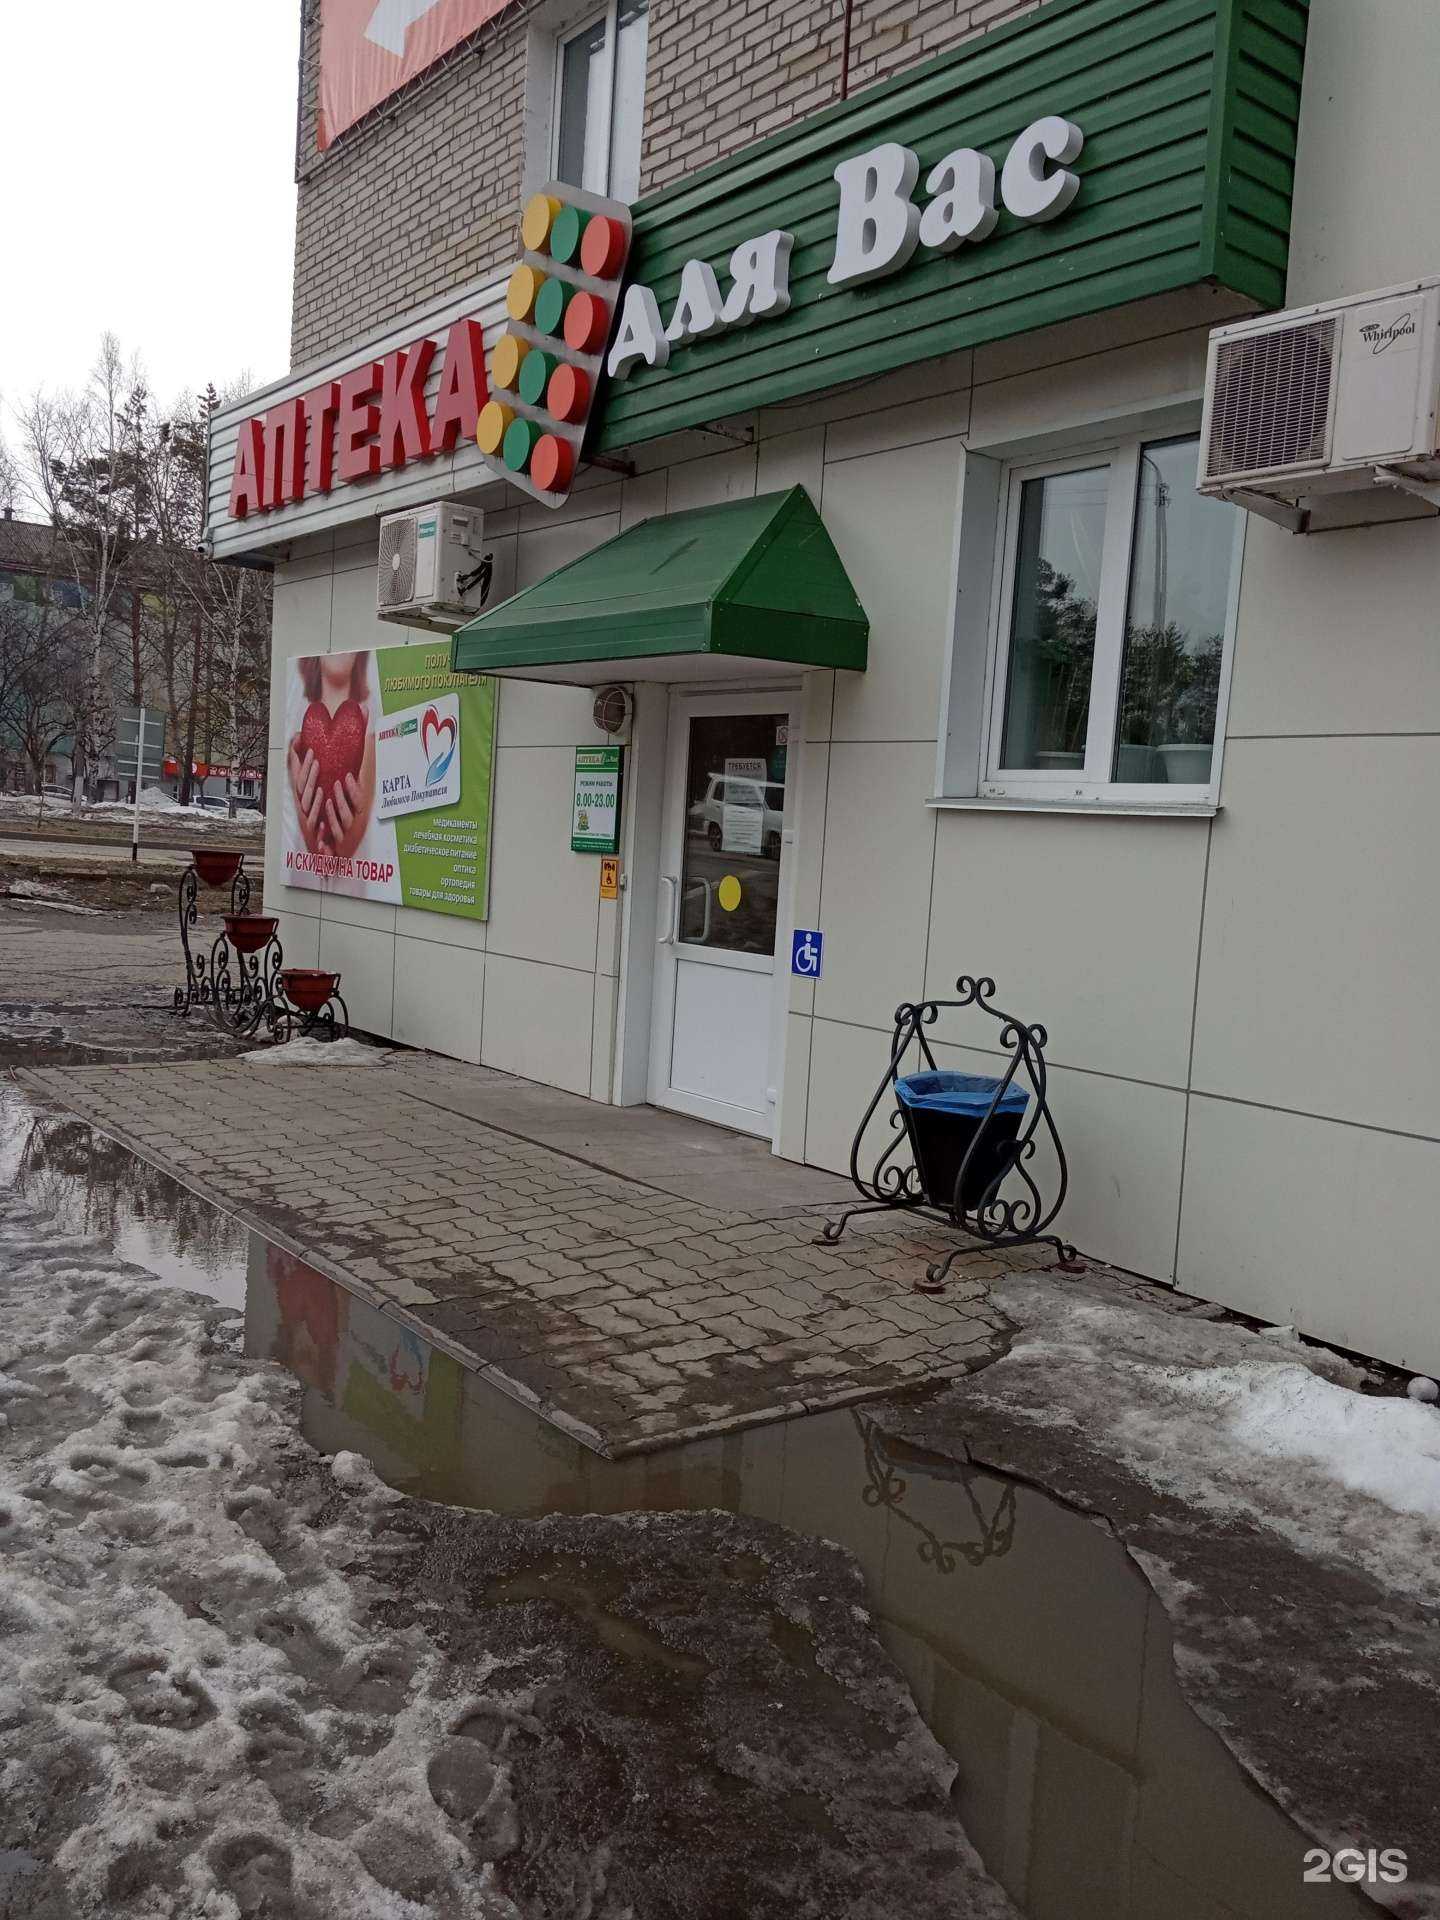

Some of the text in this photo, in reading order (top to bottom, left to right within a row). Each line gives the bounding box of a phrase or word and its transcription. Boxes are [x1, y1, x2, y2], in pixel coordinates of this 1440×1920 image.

[827, 115, 1084, 285] Вас
[1363, 321, 1416, 342] Whirlpool
[229, 318, 490, 518] АПТЕКА
[382, 774, 411, 794] КАРТА
[576, 793, 615, 808] 8.00-23.00
[433, 818, 478, 829] медикаменты
[286, 852, 394, 883] И СКИДКУ НА ТОВАР
[453, 864, 477, 874] оптика
